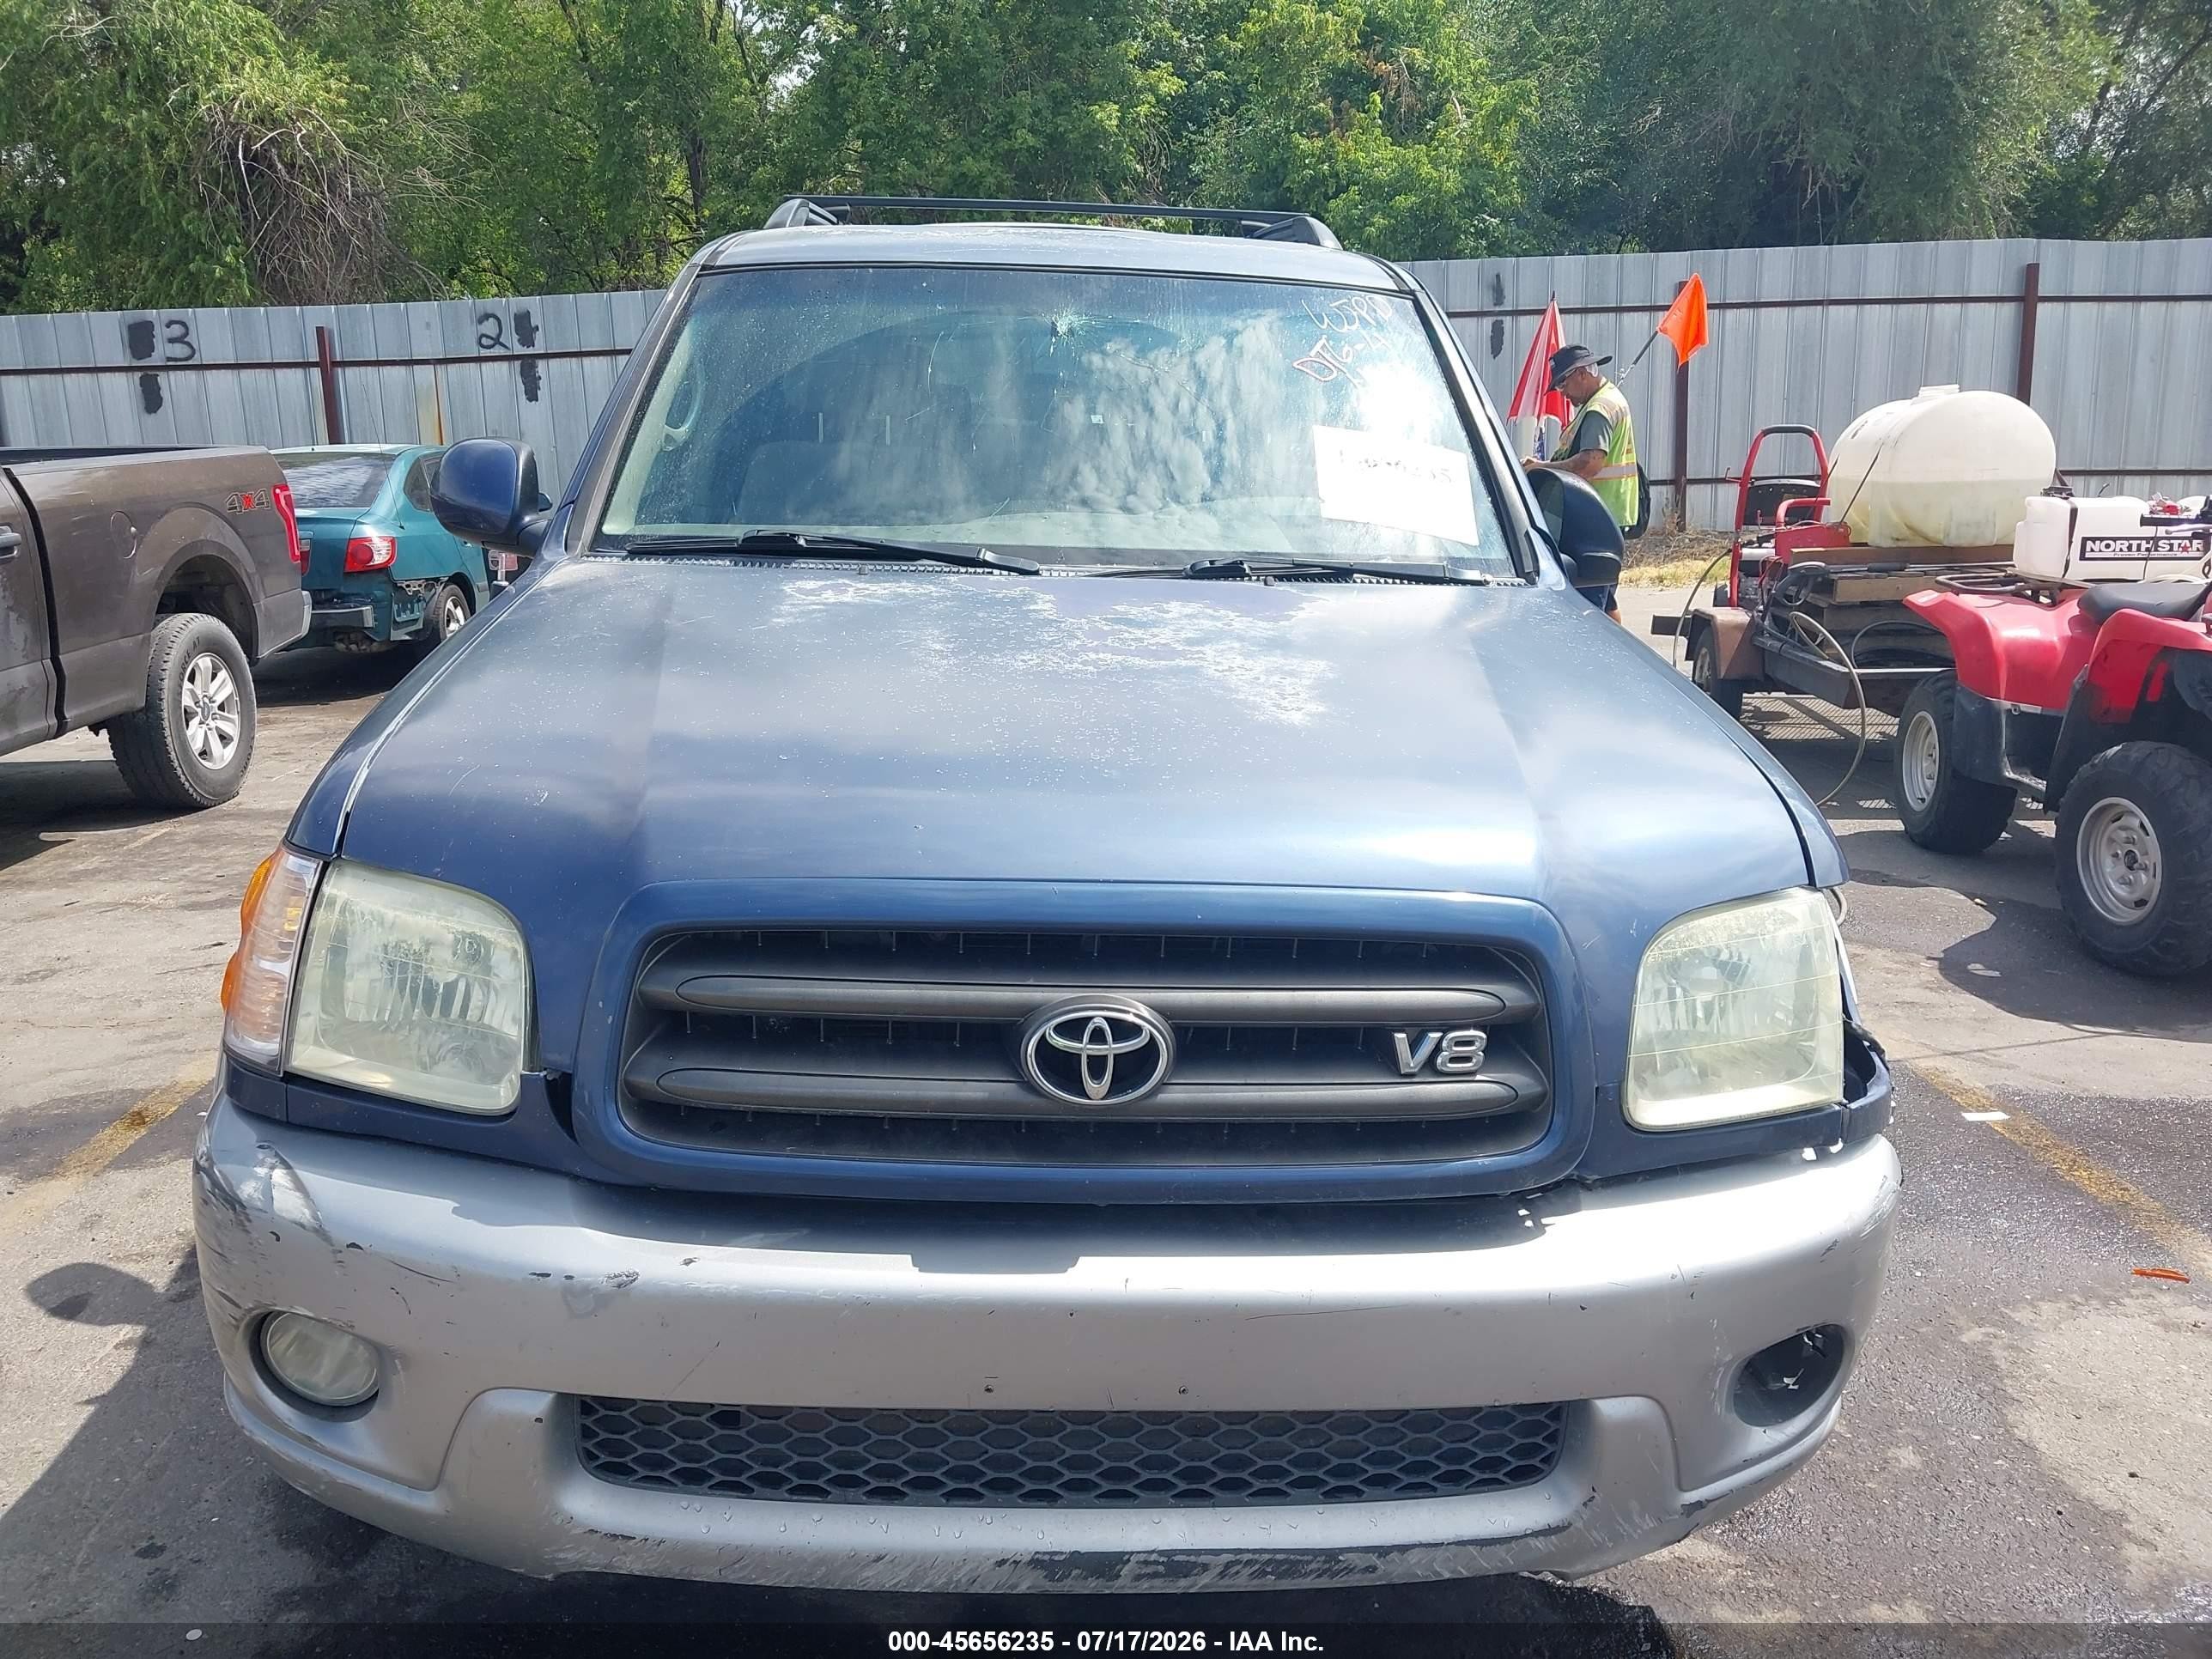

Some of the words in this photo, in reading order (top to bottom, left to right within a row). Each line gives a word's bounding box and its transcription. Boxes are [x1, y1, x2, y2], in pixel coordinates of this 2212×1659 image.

[164, 319, 196, 362] 3
[477, 313, 511, 351] 2
[1394, 1030, 1487, 1075] V8
